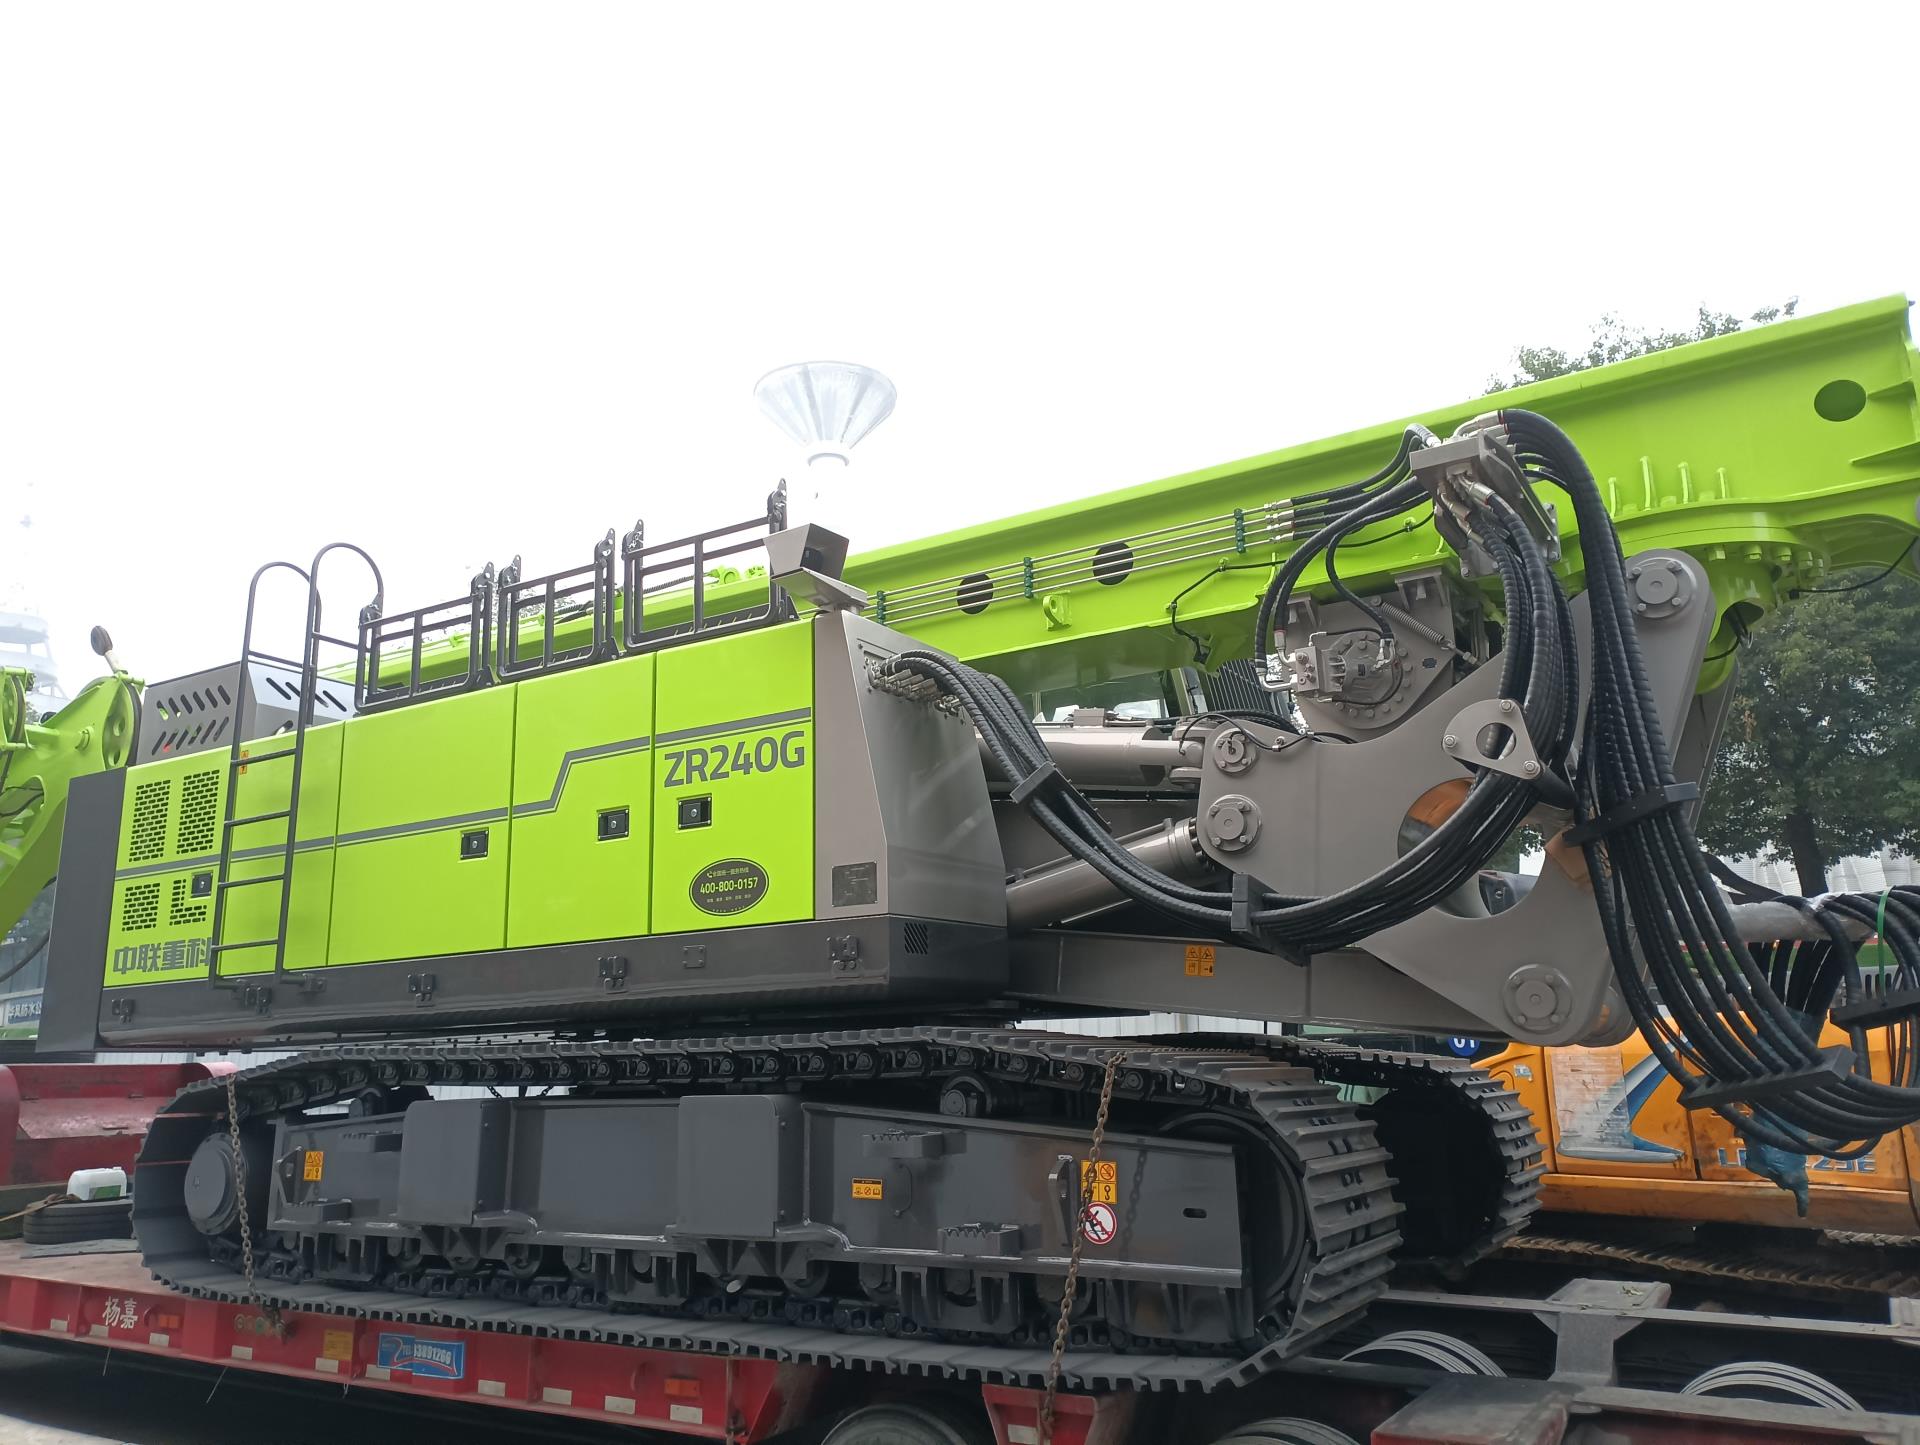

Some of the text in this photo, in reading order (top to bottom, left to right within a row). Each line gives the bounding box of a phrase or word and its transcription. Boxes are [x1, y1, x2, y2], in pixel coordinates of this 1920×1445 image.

[663, 730, 805, 788] ZR240G
[700, 877, 758, 894] 400-800-0157
[113, 937, 212, 975] 中联重科
[102, 1296, 138, 1329] 杨嘉
